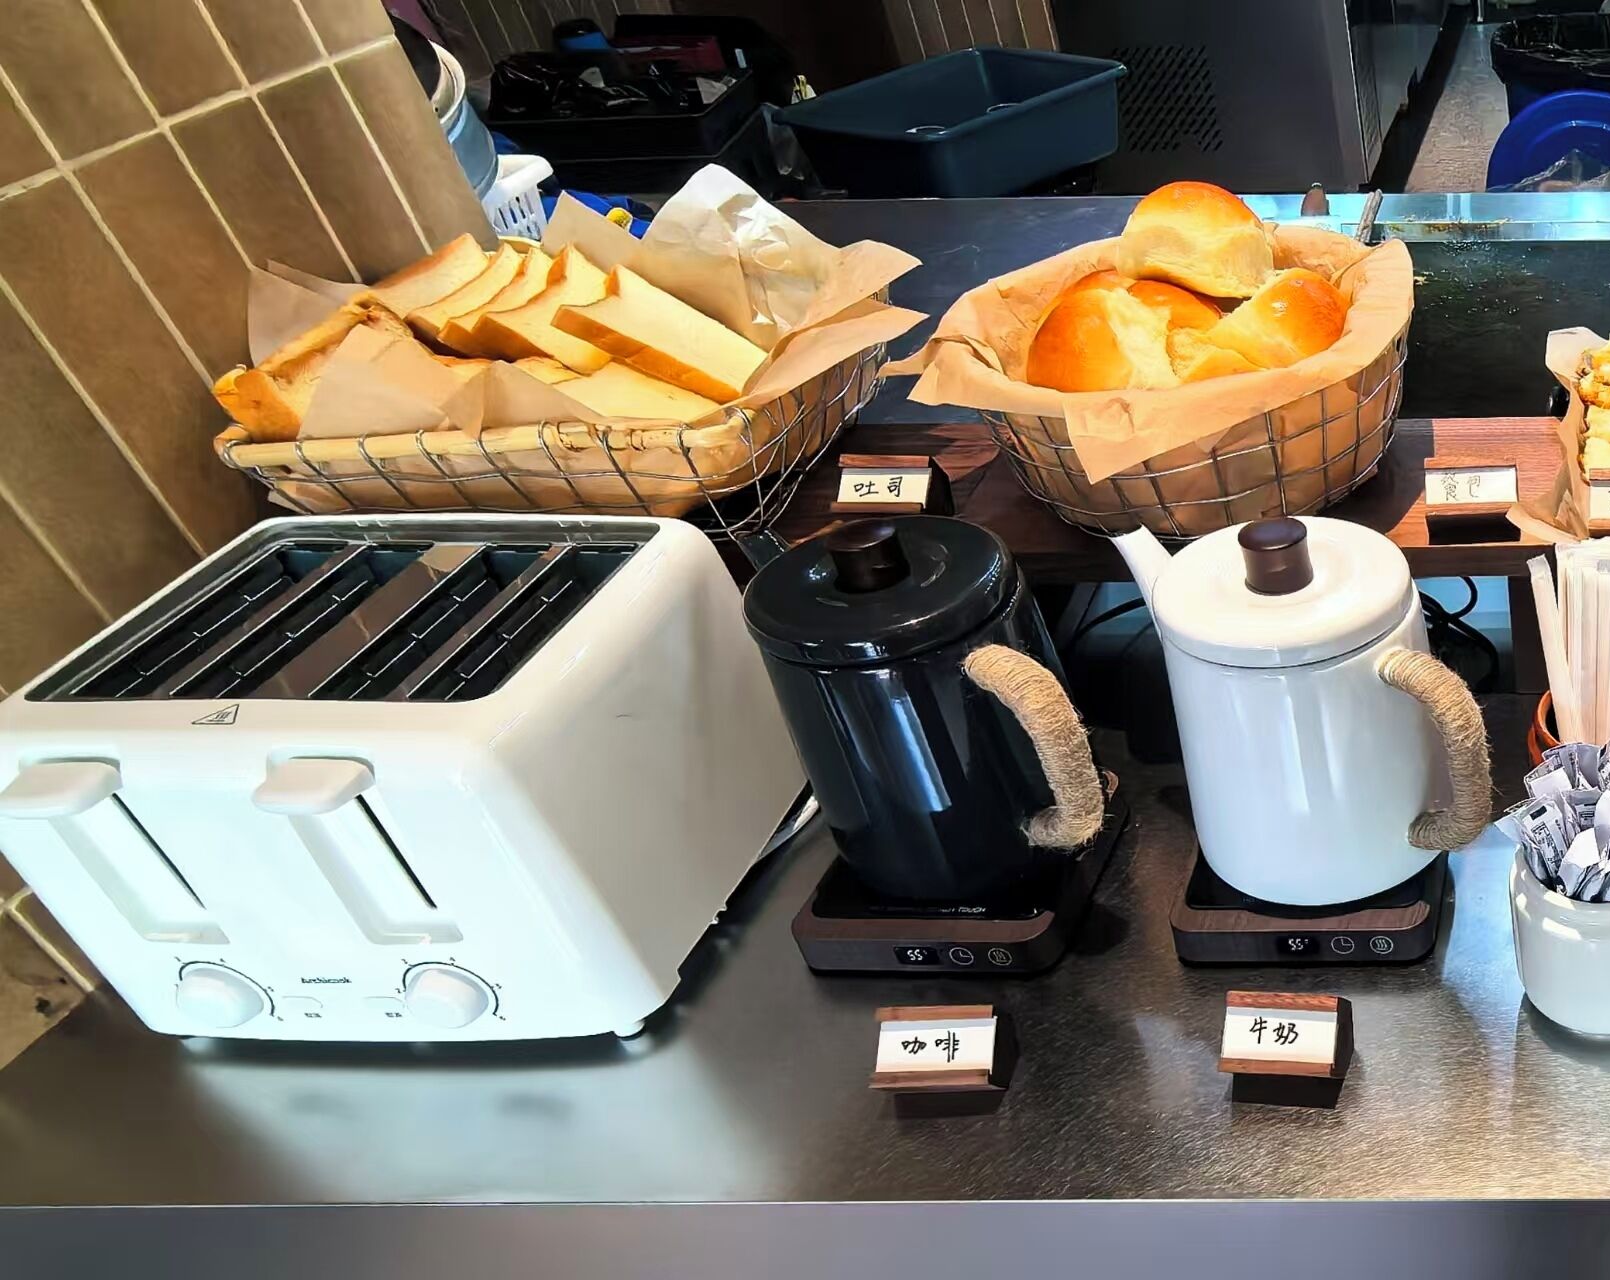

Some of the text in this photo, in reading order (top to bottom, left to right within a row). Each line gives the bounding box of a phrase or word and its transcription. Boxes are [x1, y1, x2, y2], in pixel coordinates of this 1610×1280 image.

[853, 476, 903, 497] 吐司
[1249, 1016, 1299, 1045] 牛奶
[901, 1030, 960, 1063] 咖啡
